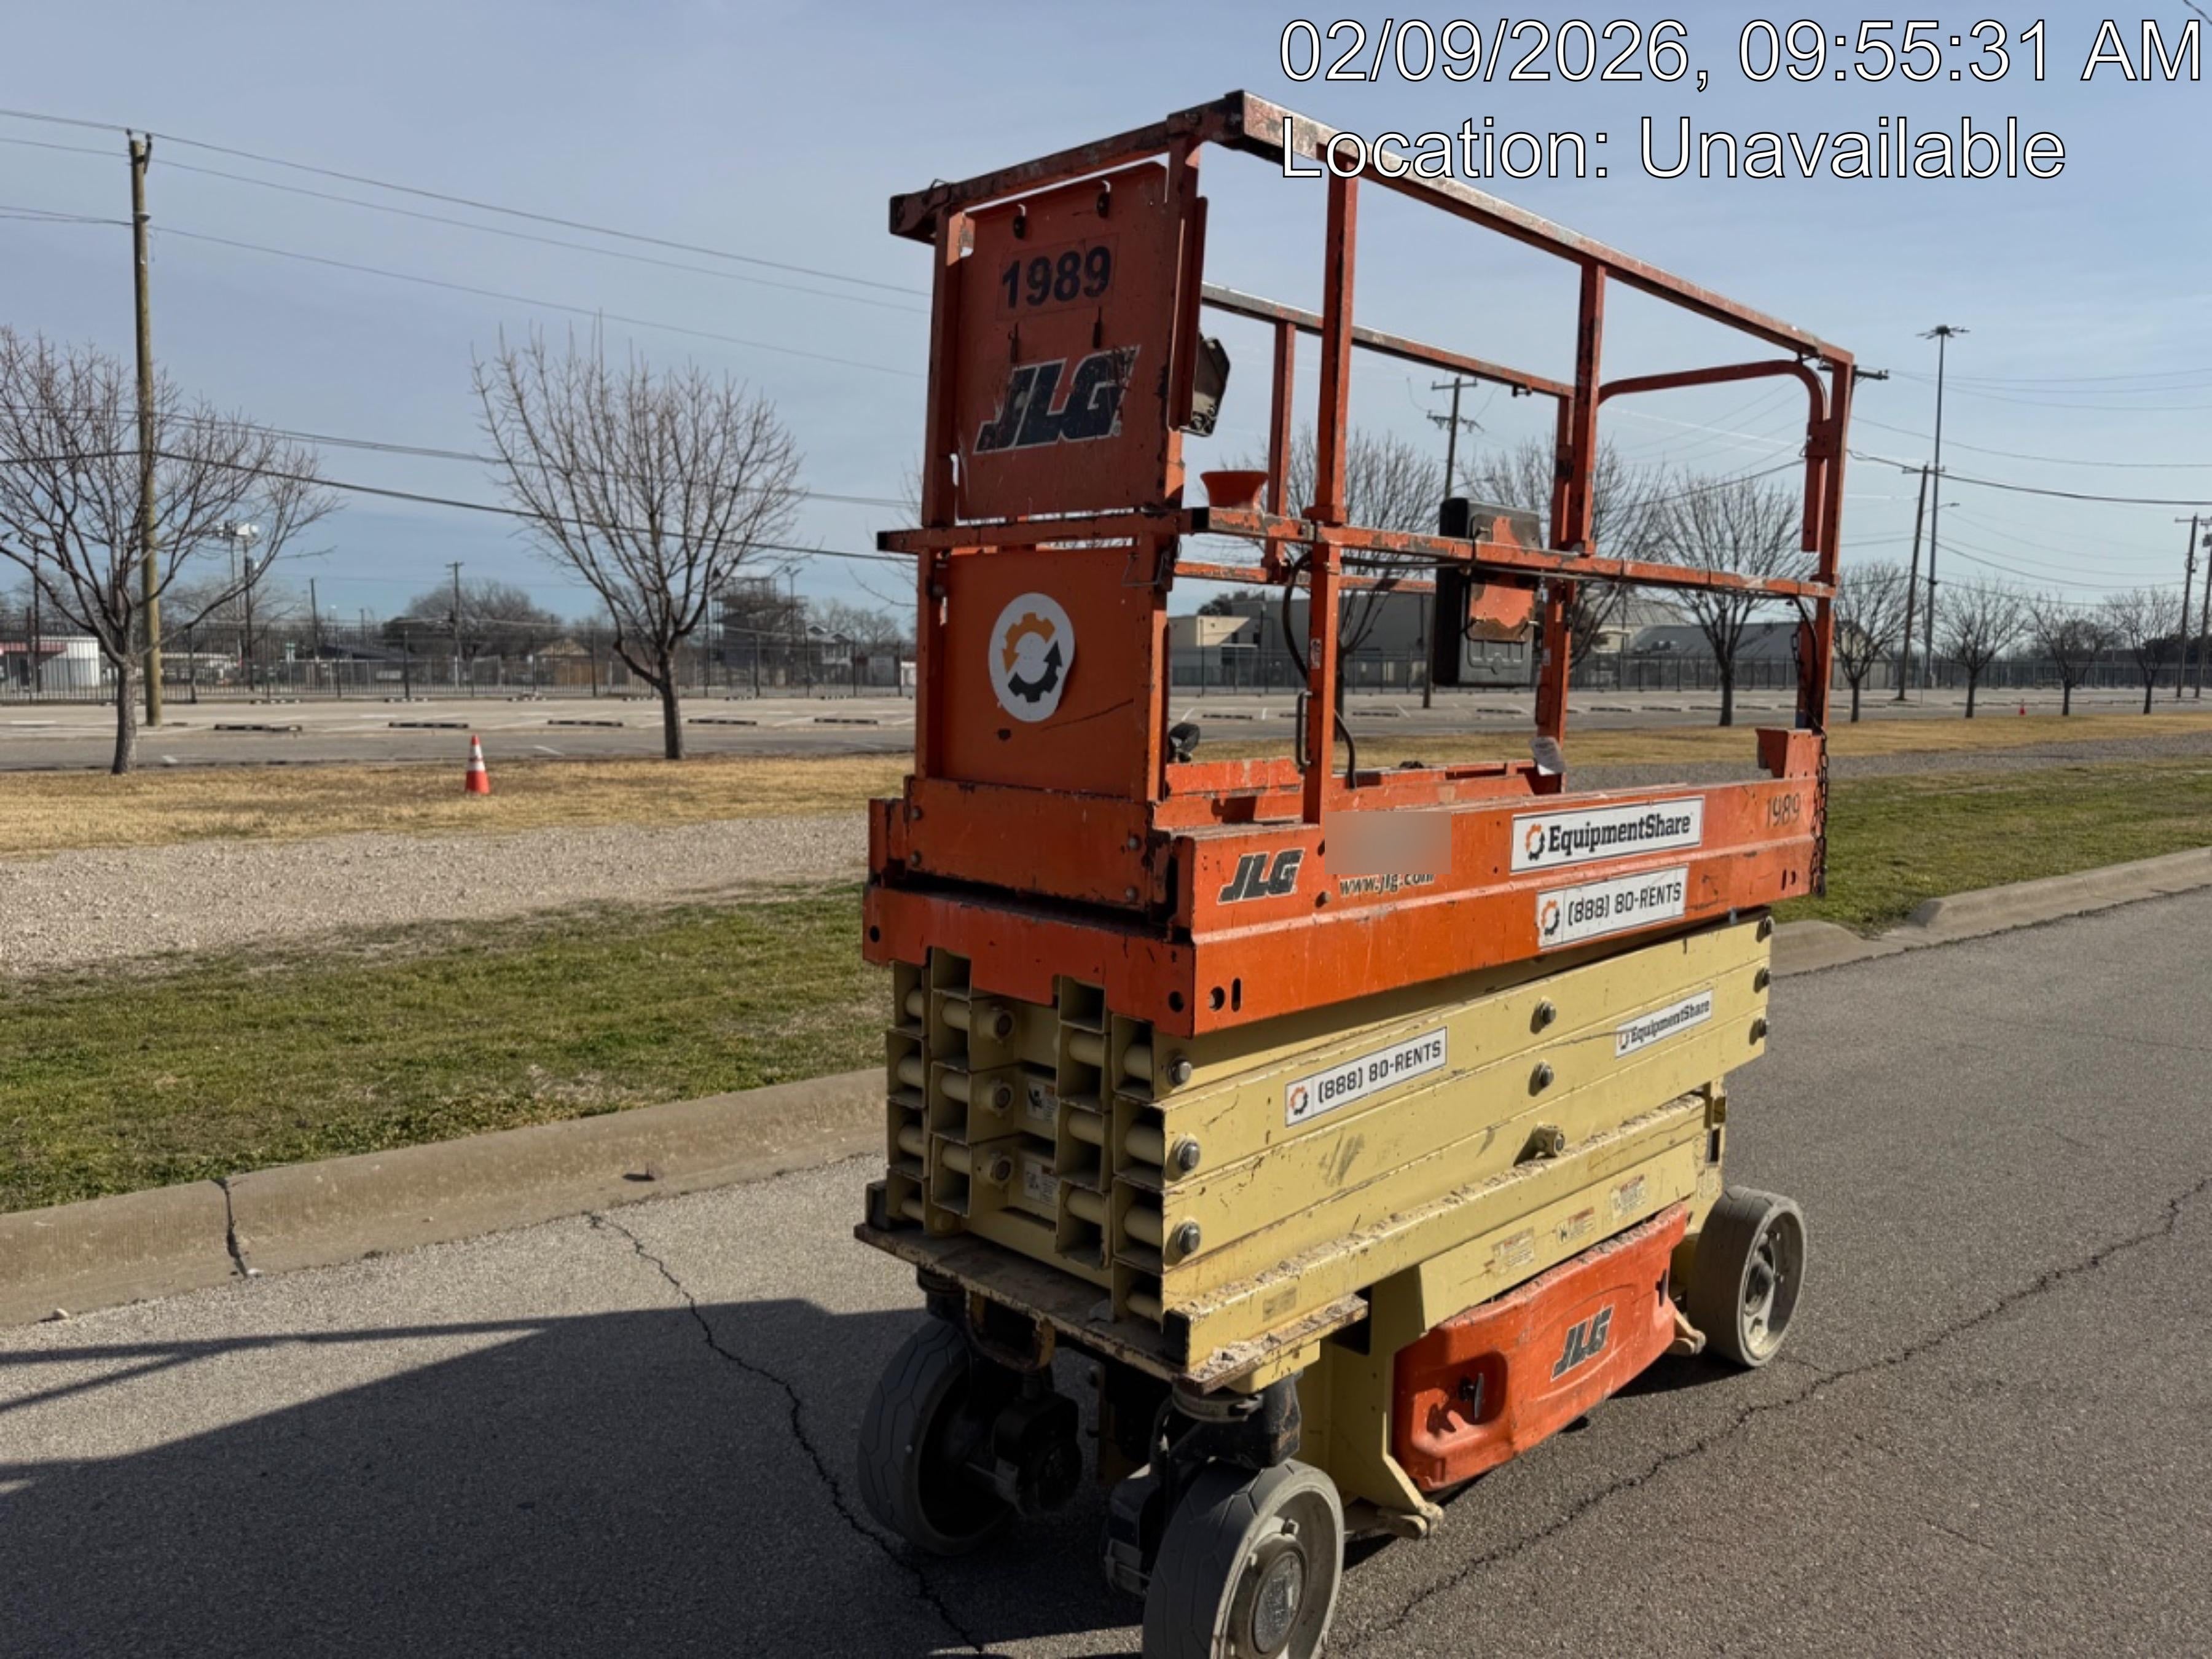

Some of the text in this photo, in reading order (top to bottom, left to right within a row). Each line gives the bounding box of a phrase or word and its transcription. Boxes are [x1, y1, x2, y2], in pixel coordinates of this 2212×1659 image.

[1002, 246, 1111, 308] 1989
[973, 345, 1141, 454] JLG
[1548, 813, 1691, 856] EquipmentShare
[1767, 791, 1801, 830] 1989
[1217, 847, 1306, 905] JLG
[1568, 882, 1681, 925] (888) 80-RENTS
[1631, 1000, 1709, 1043] EquipmentShare
[1317, 1040, 1440, 1102] (888) 80-RENTS
[1550, 1304, 1615, 1382] JLG
